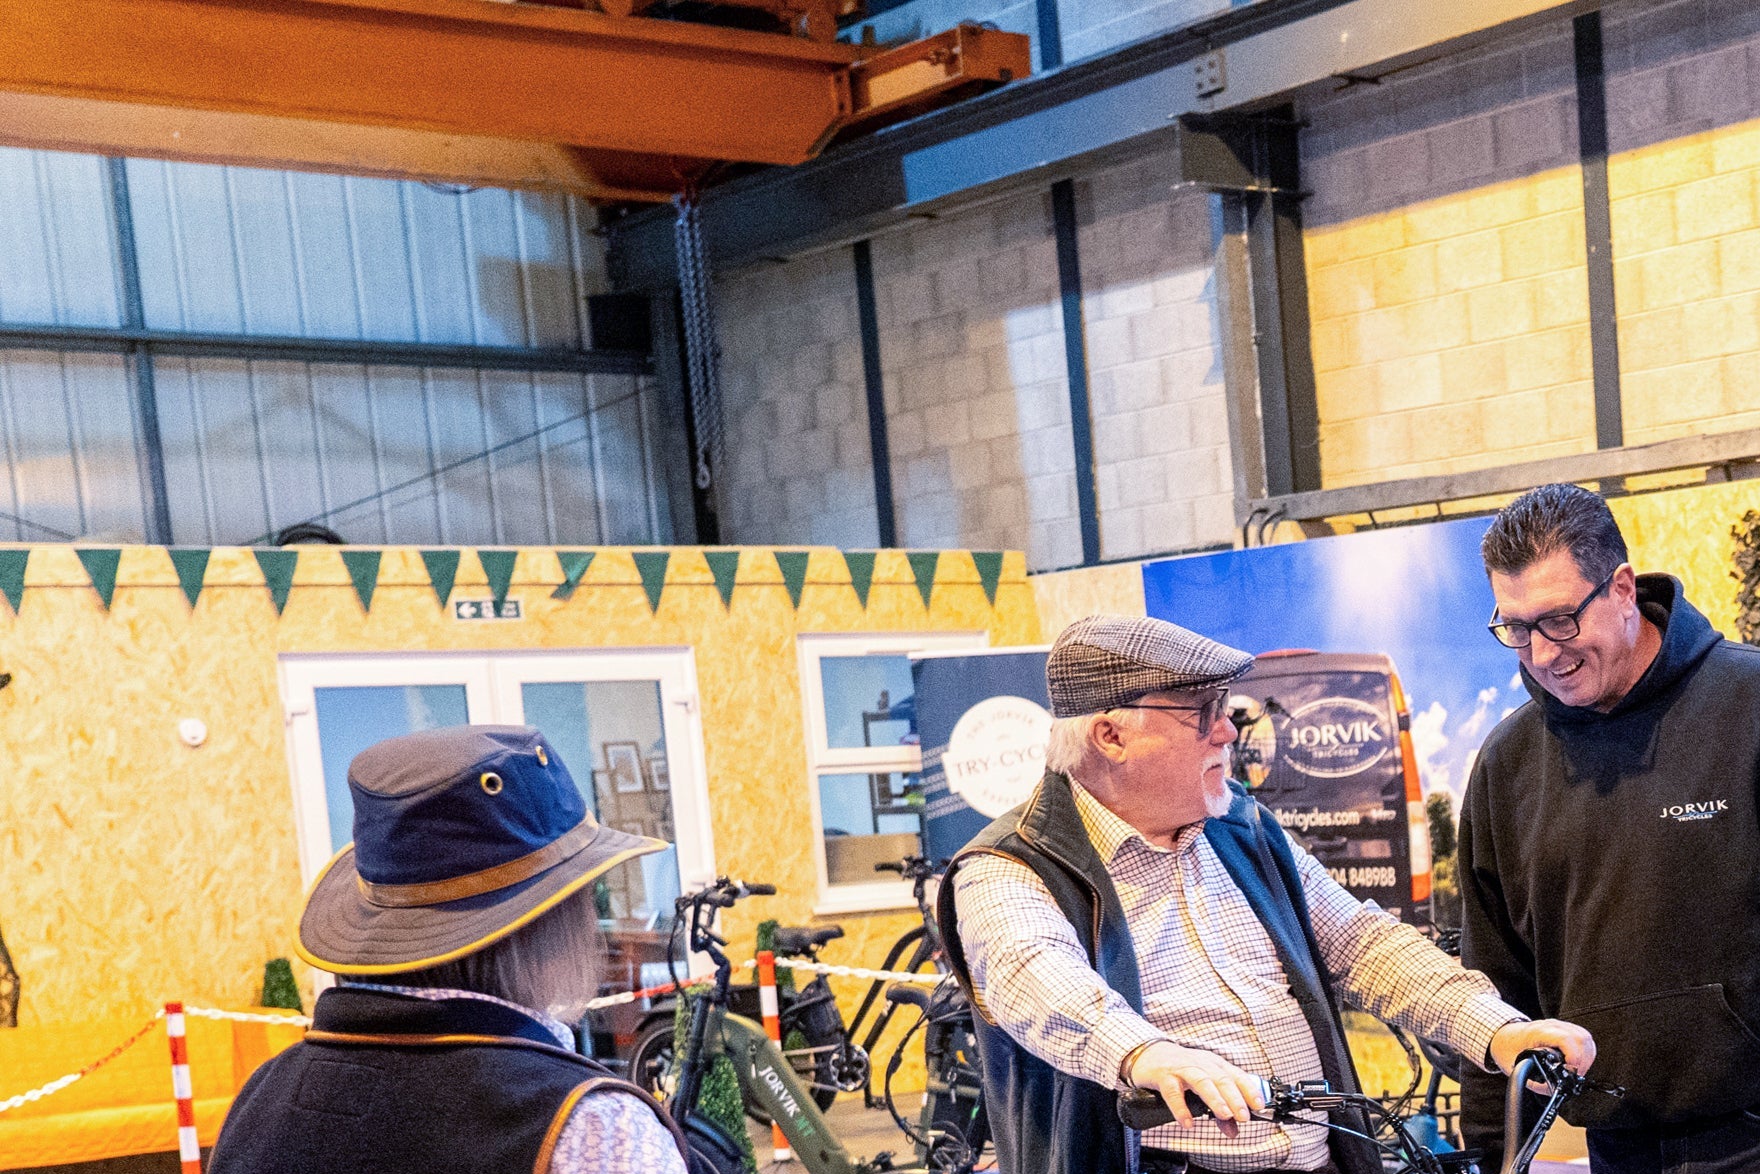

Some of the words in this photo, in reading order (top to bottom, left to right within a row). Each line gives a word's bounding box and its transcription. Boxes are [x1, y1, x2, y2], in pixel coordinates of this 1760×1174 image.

[1290, 720, 1382, 749] JORVIK
[1660, 800, 1728, 818] JORVIK
[1678, 813, 1713, 822] TRICYCLES
[1349, 866, 1397, 887] 848988
[759, 1065, 800, 1119] JORVIK
